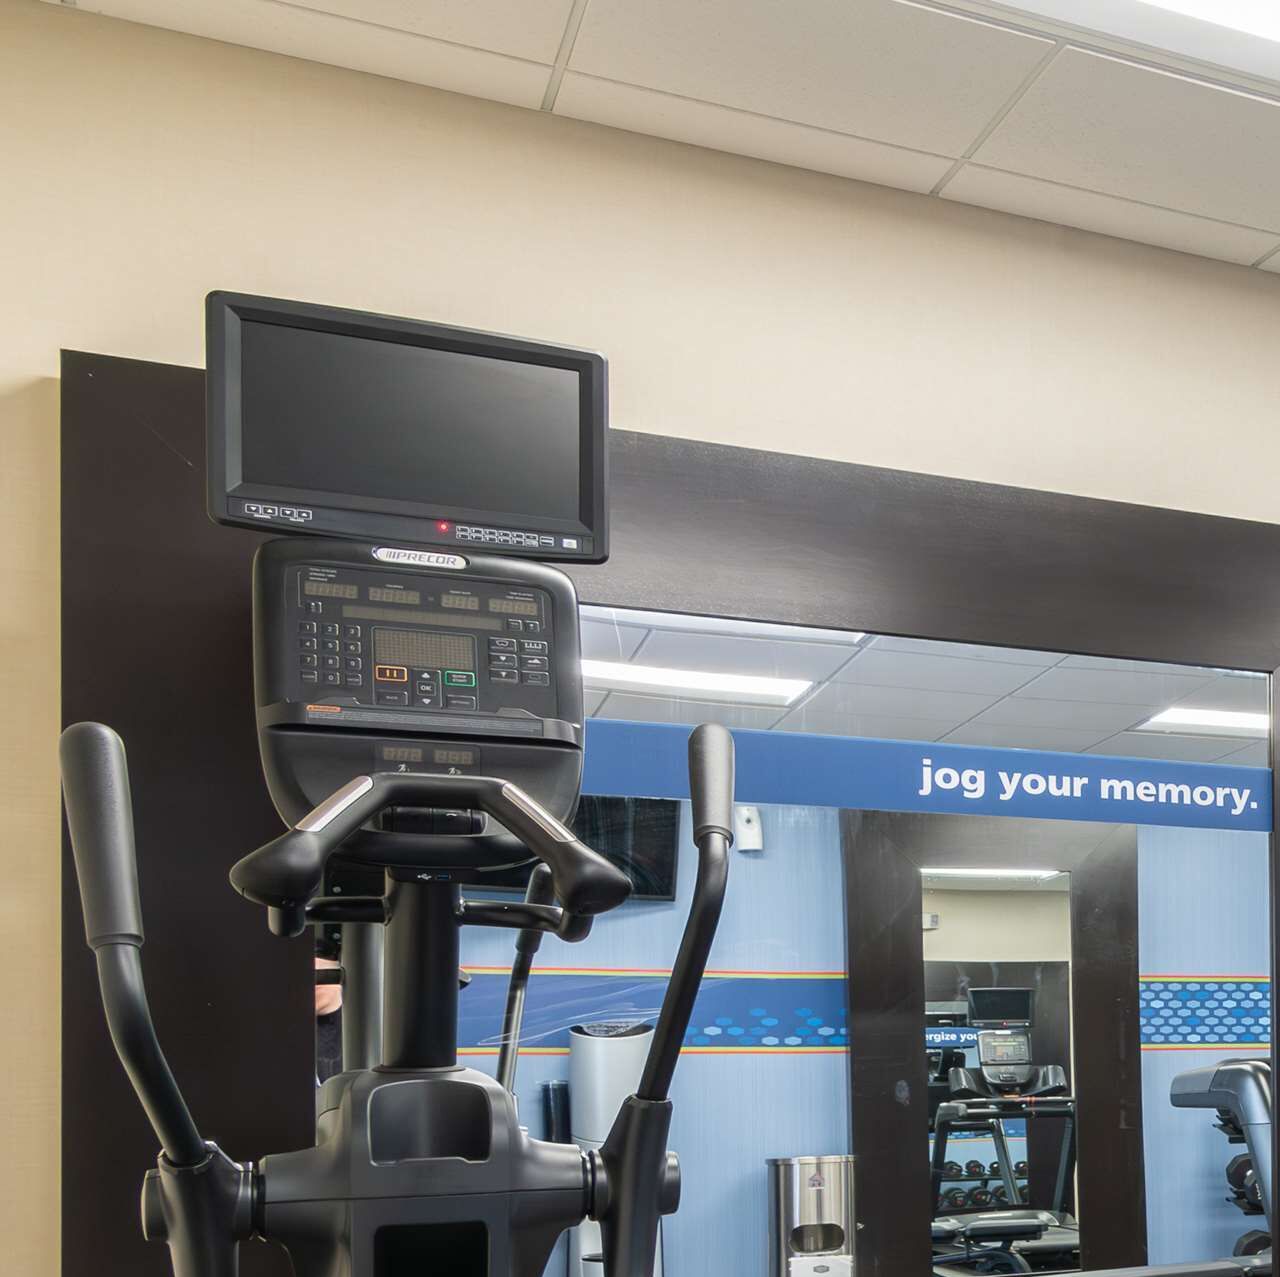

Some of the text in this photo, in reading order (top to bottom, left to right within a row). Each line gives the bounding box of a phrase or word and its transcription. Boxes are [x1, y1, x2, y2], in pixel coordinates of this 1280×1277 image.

[386, 550, 457, 566] PRECOR
[918, 758, 1258, 815] jog your memory.
[959, 1033, 978, 1043] you
